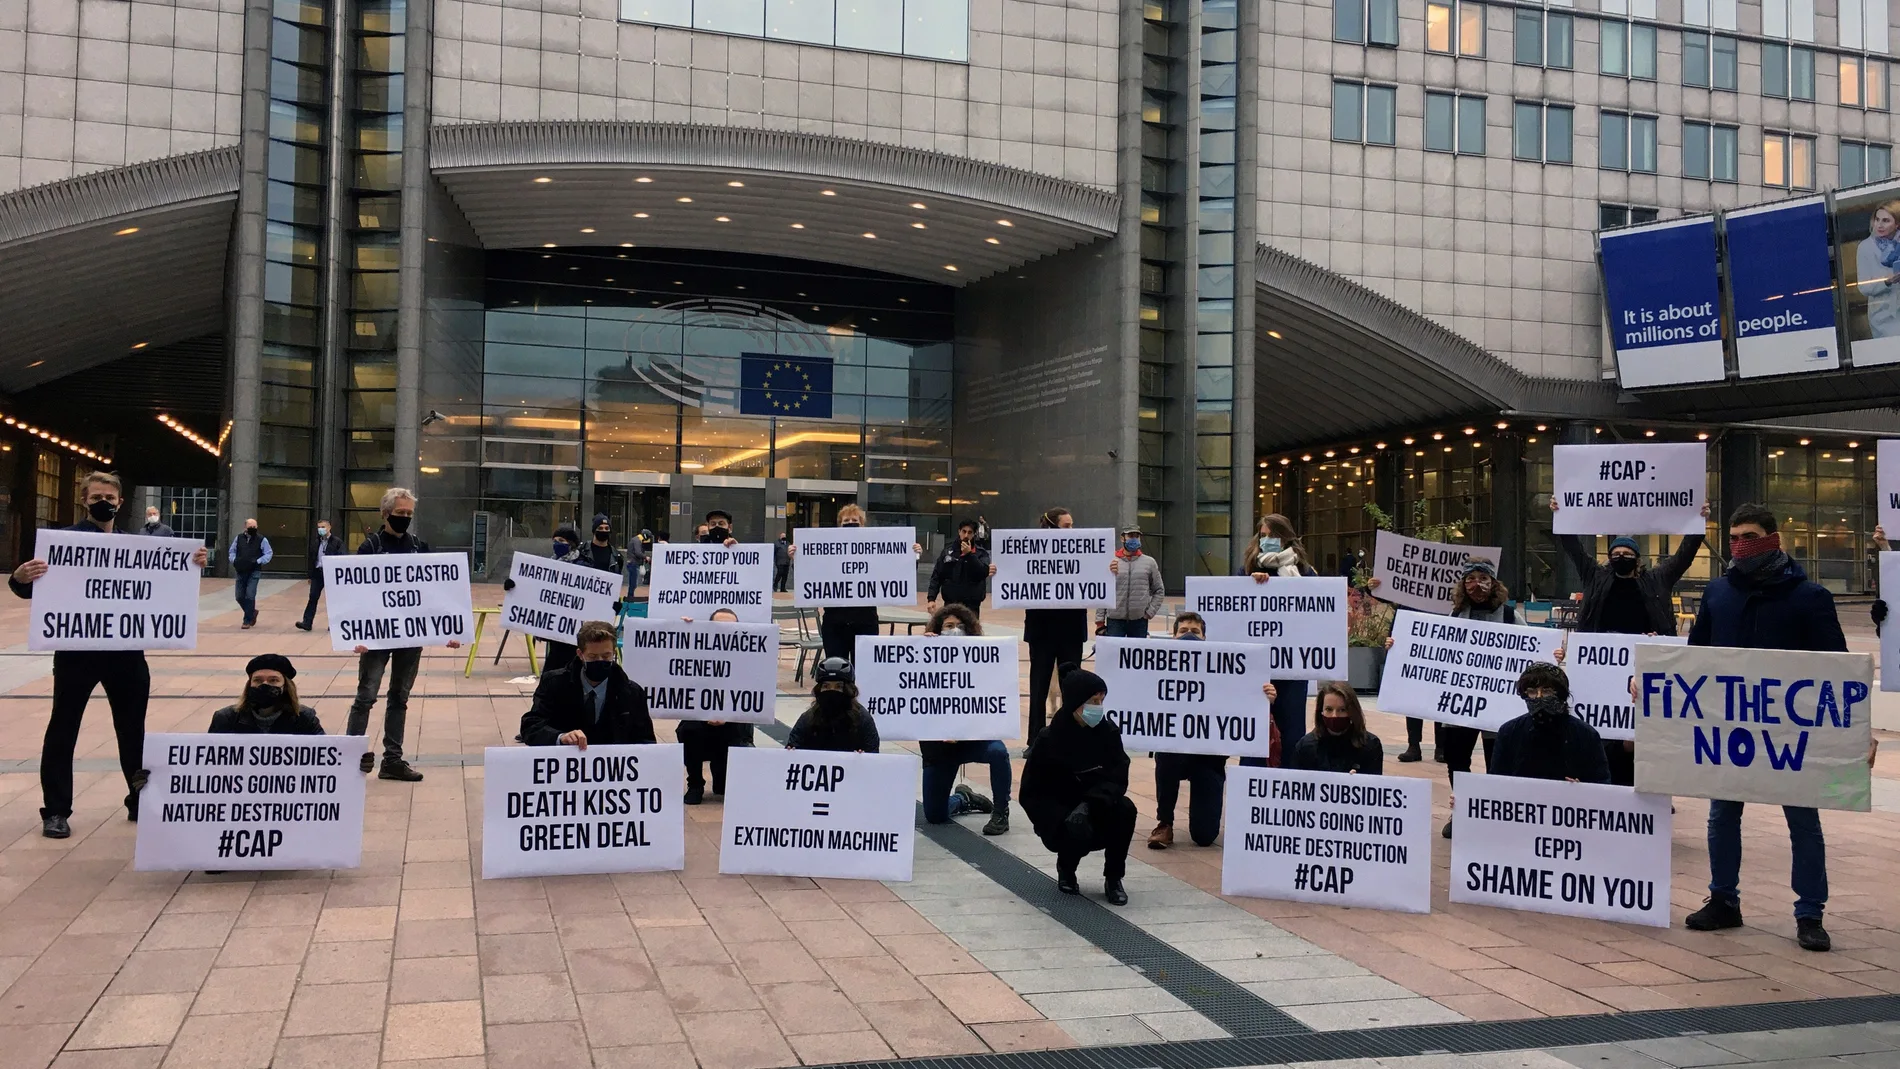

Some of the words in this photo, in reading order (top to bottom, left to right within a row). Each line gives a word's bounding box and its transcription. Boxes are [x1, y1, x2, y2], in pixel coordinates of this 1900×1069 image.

[1625, 311, 1636, 324] It
[1641, 308, 1653, 322] is
[1659, 302, 1712, 320] about
[1626, 326, 1693, 344] millions
[1699, 319, 1717, 336] of
[1739, 310, 1807, 336] people.
[1599, 461, 1645, 480] #CAP
[1564, 492, 1583, 507] WE
[1587, 492, 1613, 507] ARE
[1617, 489, 1693, 507] WATCHING!
[803, 543, 848, 555] HERBERT
[852, 542, 906, 554] DORFMANN
[1000, 536, 1044, 555] JÉRÉMY
[1052, 539, 1106, 554] DECERLE
[1403, 543, 1419, 559] EP
[48, 545, 110, 567] MARTIN
[114, 545, 190, 571] HLAVÁČEK
[666, 551, 698, 564] MEPS:
[702, 552, 729, 564] STOP
[732, 552, 759, 565] YOUR
[842, 562, 868, 574] (EPP)
[1027, 560, 1079, 574] (RENEW)
[1387, 557, 1428, 580] DEATH
[335, 567, 380, 585] PAOLO
[385, 566, 402, 583] DE
[406, 564, 458, 582] CASTRO
[519, 563, 559, 583] MARTIN
[561, 572, 613, 596] HLAVÁČEK
[683, 571, 739, 584] SHAMEFUL
[86, 579, 151, 600] (RENEW)
[383, 590, 421, 607] (S&D)
[540, 589, 584, 610] (RENEW)
[659, 591, 687, 603] #CAP
[690, 591, 762, 604] COMPROMISE
[804, 582, 853, 599] SHAME
[858, 581, 876, 598] ON
[881, 581, 907, 597] YOU
[1001, 583, 1050, 600] SHAME
[1056, 583, 1074, 599] ON
[1079, 583, 1106, 599] YOU
[1392, 576, 1434, 599] GREEN
[1437, 586, 1453, 601] DE
[1198, 596, 1256, 611] HERBERT
[1261, 596, 1334, 612] DORFMANN
[43, 612, 113, 638] SHAME
[120, 614, 144, 638] ON
[151, 614, 186, 638] YOU
[341, 618, 400, 640] SHAME
[405, 617, 427, 637] ON
[431, 615, 463, 635] YOU
[509, 606, 556, 630] SHAME
[558, 617, 577, 635] ON
[1248, 621, 1282, 637] (EPP)
[635, 630, 690, 649] MARTIN
[695, 631, 767, 652] HLAVÁČEK
[1412, 621, 1428, 637] EU
[1431, 624, 1467, 643] FARM
[1470, 630, 1540, 652] SUBSIDIES:
[874, 645, 918, 663] MEPS:
[924, 647, 958, 663] STOP
[963, 646, 999, 663] YOUR
[1120, 648, 1201, 672] NORBERT
[1207, 652, 1246, 674] LINS
[1270, 647, 1292, 669] ON
[1299, 647, 1335, 669] YOU
[1410, 644, 1463, 664] BILLIONS
[1466, 653, 1502, 670] GOING
[1578, 646, 1629, 666] PAOLO
[669, 659, 730, 677] (RENEW)
[1401, 664, 1448, 684] NATURE
[1451, 672, 1518, 695] DESTRUCTI
[899, 672, 975, 689] SHAMEFUL
[1158, 679, 1204, 702] (EPP)
[645, 687, 695, 709] HAME
[701, 689, 724, 711] ON
[730, 690, 764, 713] YOU
[868, 697, 906, 715] #CAP
[910, 697, 1006, 714] COMPROMISE
[1438, 691, 1487, 717] #CAP
[1183, 714, 1209, 739] ON
[1216, 716, 1255, 741] YOU
[1574, 703, 1635, 729] SHAM
[169, 746, 190, 765] EU
[196, 746, 244, 765] FARM
[249, 746, 342, 766] SUBSIDIES:
[1694, 725, 1808, 771] NOW
[533, 758, 559, 784] EP
[566, 756, 638, 783] BLOWS
[786, 764, 844, 792] #CAP
[170, 775, 243, 793] BILLIONS
[248, 775, 295, 793] GOING
[301, 775, 336, 793] INTO
[1249, 779, 1267, 798] EU
[1272, 780, 1315, 801] FARM
[1320, 784, 1407, 808] SUBSIDIES:
[163, 804, 226, 822] NATURE
[231, 803, 339, 821] DESTRUCTION
[508, 791, 576, 818] DEATH
[584, 789, 630, 815] KISS
[637, 788, 661, 813] TO
[1251, 807, 1315, 828] BILLIONS
[1320, 812, 1364, 832] GOING
[1369, 816, 1402, 836] INTO
[1469, 798, 1547, 824] HERBERT
[1552, 806, 1653, 835] DORFMANN
[218, 830, 282, 857] #CAP
[520, 823, 589, 851] GREEN
[598, 821, 650, 848] DEAL
[735, 827, 824, 848] EXTINCTION
[828, 830, 898, 852] MACHINE
[1245, 833, 1301, 855] NATURE
[1306, 838, 1407, 864] DESTRUCTION
[1535, 837, 1581, 860] (EPP)
[1295, 864, 1353, 894] #CAP
[1467, 863, 1553, 899] SHAME
[1562, 873, 1594, 904] ON
[1603, 877, 1653, 910] YOU
